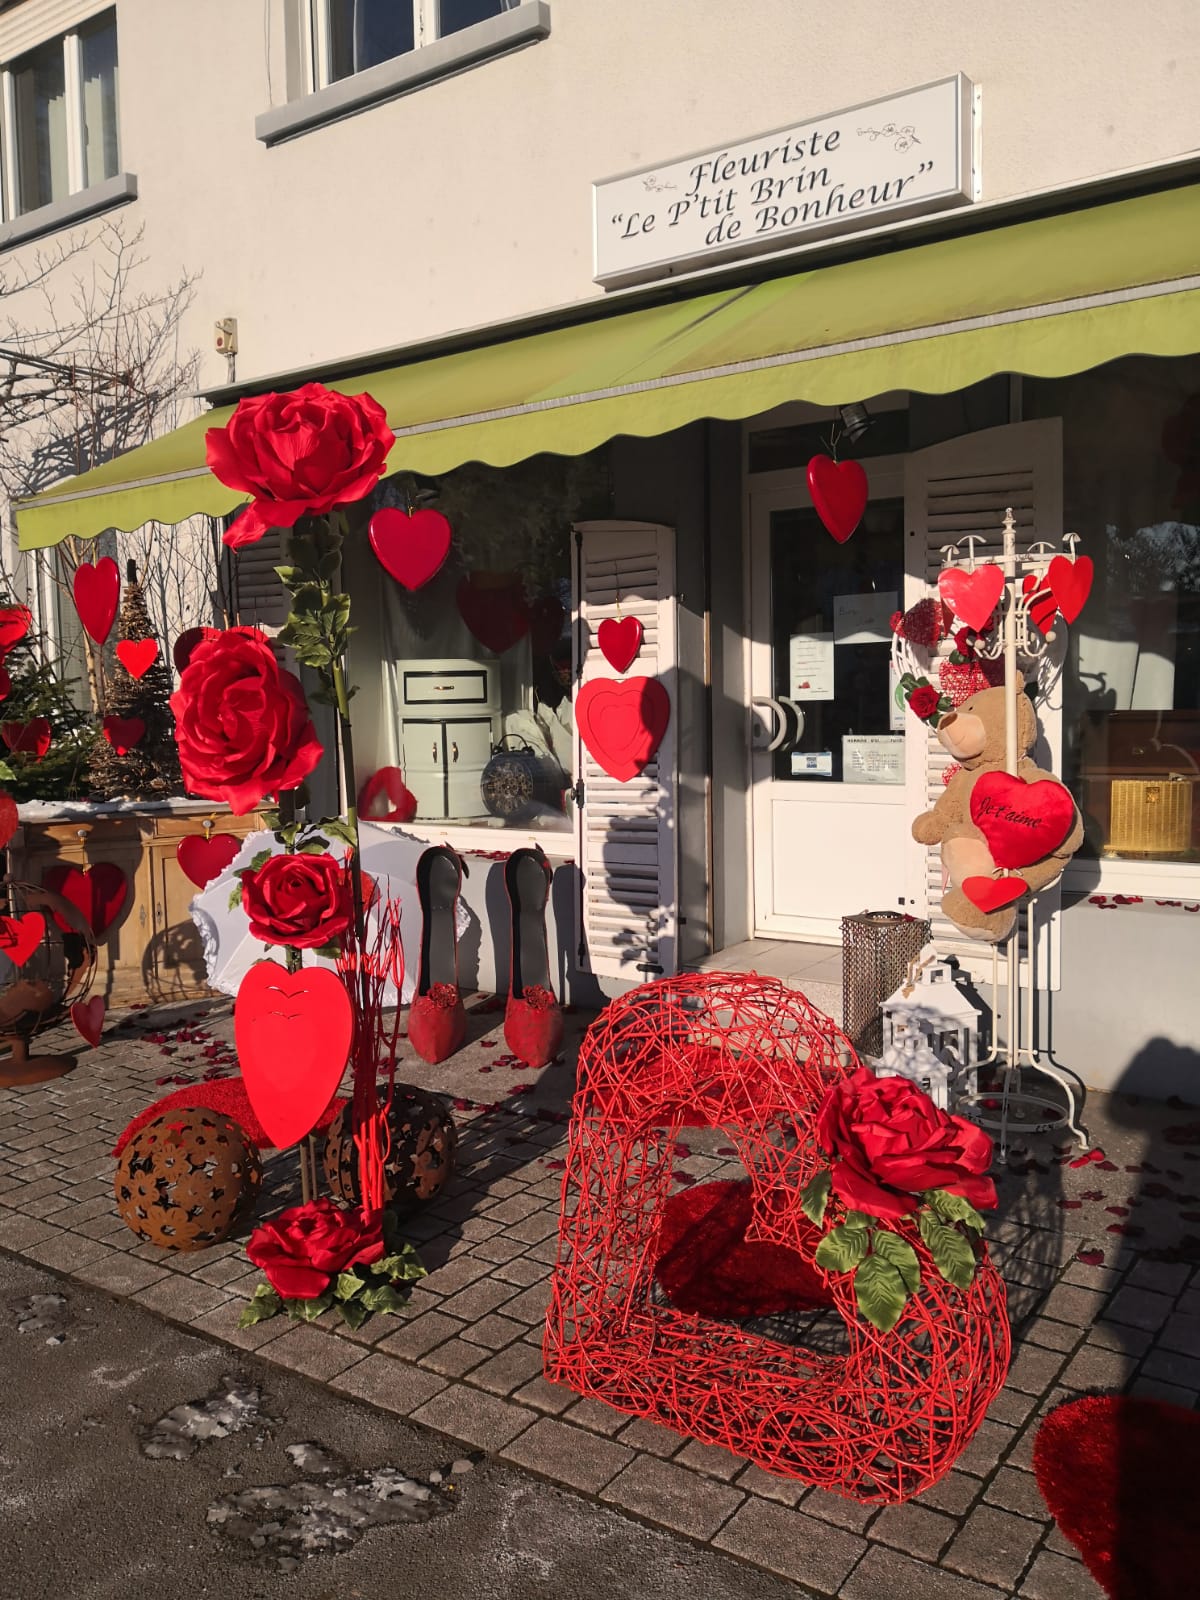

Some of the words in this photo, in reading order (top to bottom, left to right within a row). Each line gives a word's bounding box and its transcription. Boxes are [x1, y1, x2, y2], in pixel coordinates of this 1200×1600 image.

[685, 129, 842, 197] Fleuriste
[750, 165, 832, 206] Brin
[705, 217, 742, 246] de
[976, 797, 995, 819] Je
